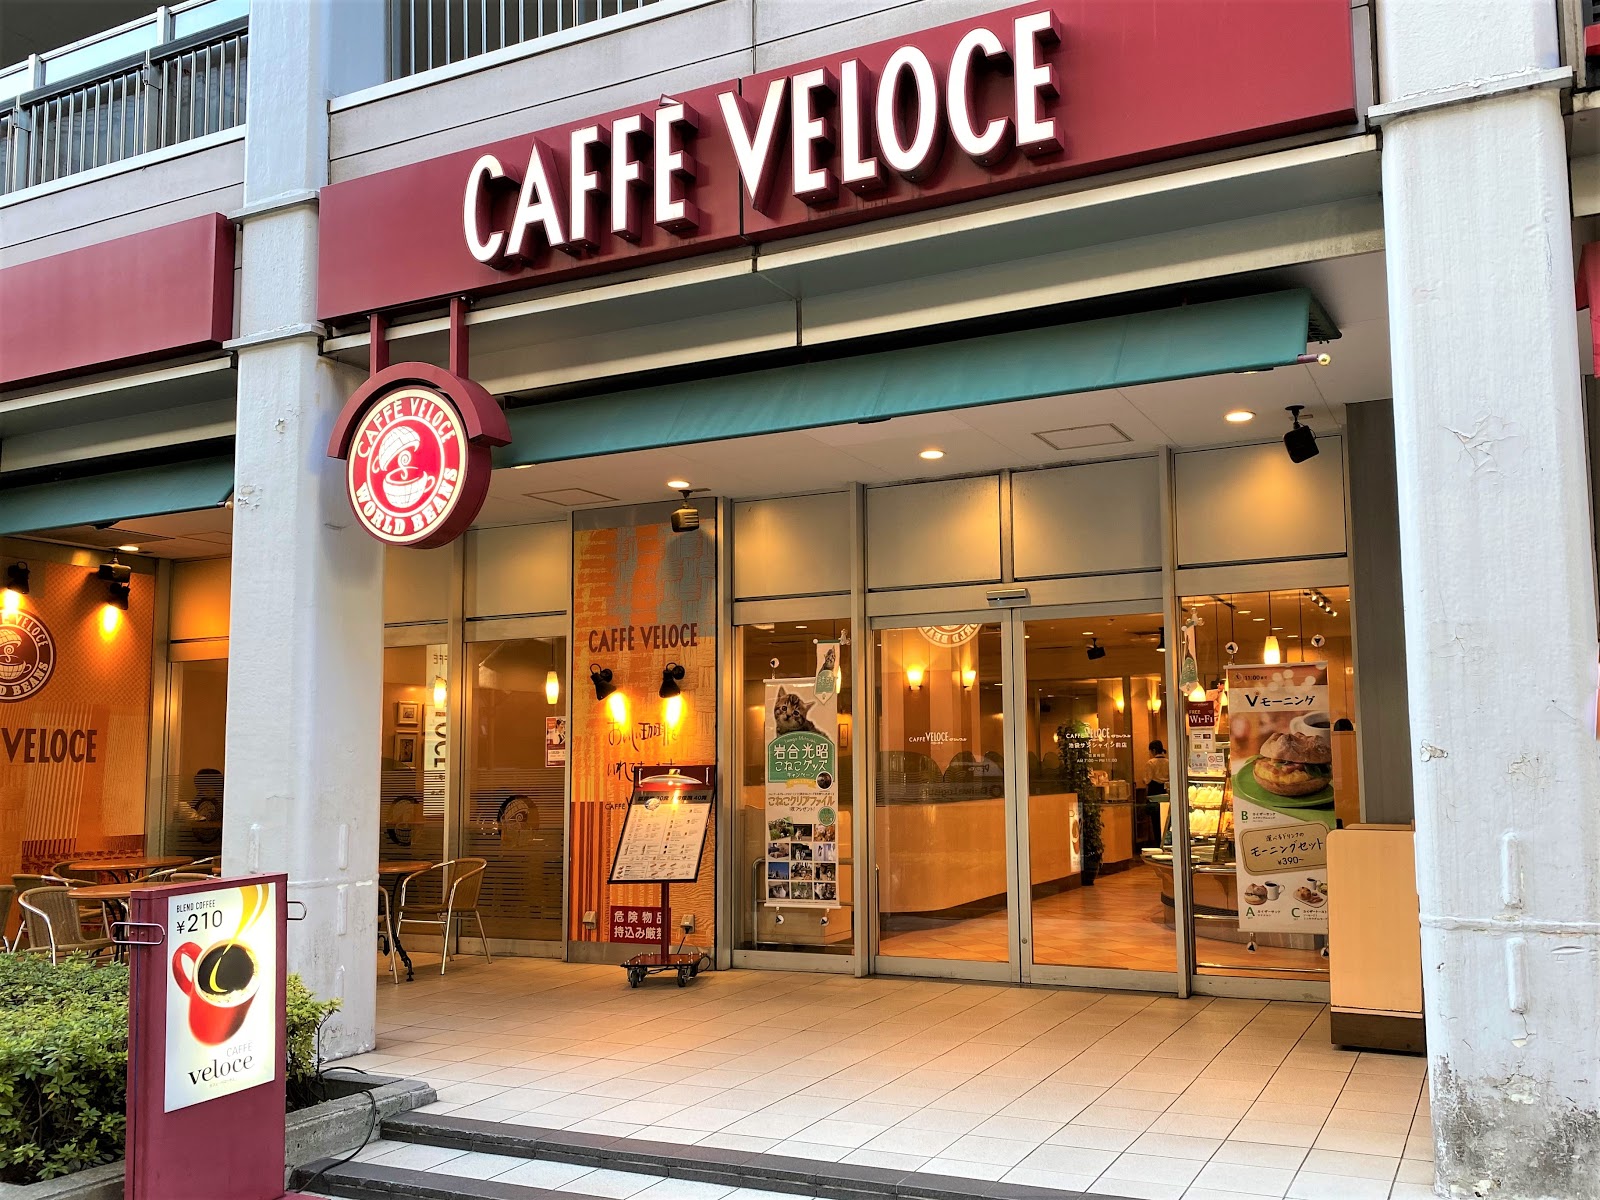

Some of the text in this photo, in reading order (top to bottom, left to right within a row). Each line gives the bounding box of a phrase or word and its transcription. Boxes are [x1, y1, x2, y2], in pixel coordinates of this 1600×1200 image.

[716, 10, 1057, 207] VELOCE
[410, 397, 455, 444] VELOCE
[356, 467, 458, 535] WORLD BEANS
[16, 613, 49, 647] VELOCE
[640, 622, 698, 650] VELOCE
[12, 661, 49, 697] BEANS
[1, 727, 98, 763] VELOCE
[925, 731, 949, 742] VELOCE
[774, 760, 828, 772] こねこグッズ
[768, 795, 836, 806] こねこクリアファイル
[1241, 810, 1249, 821] B
[1250, 837, 1324, 857] モーニングセット
[176, 899, 216, 913] BLEND COFFEE
[1245, 906, 1255, 917] A
[1291, 907, 1300, 918] C
[176, 909, 223, 934] ¥210
[188, 1053, 256, 1086] veloce
